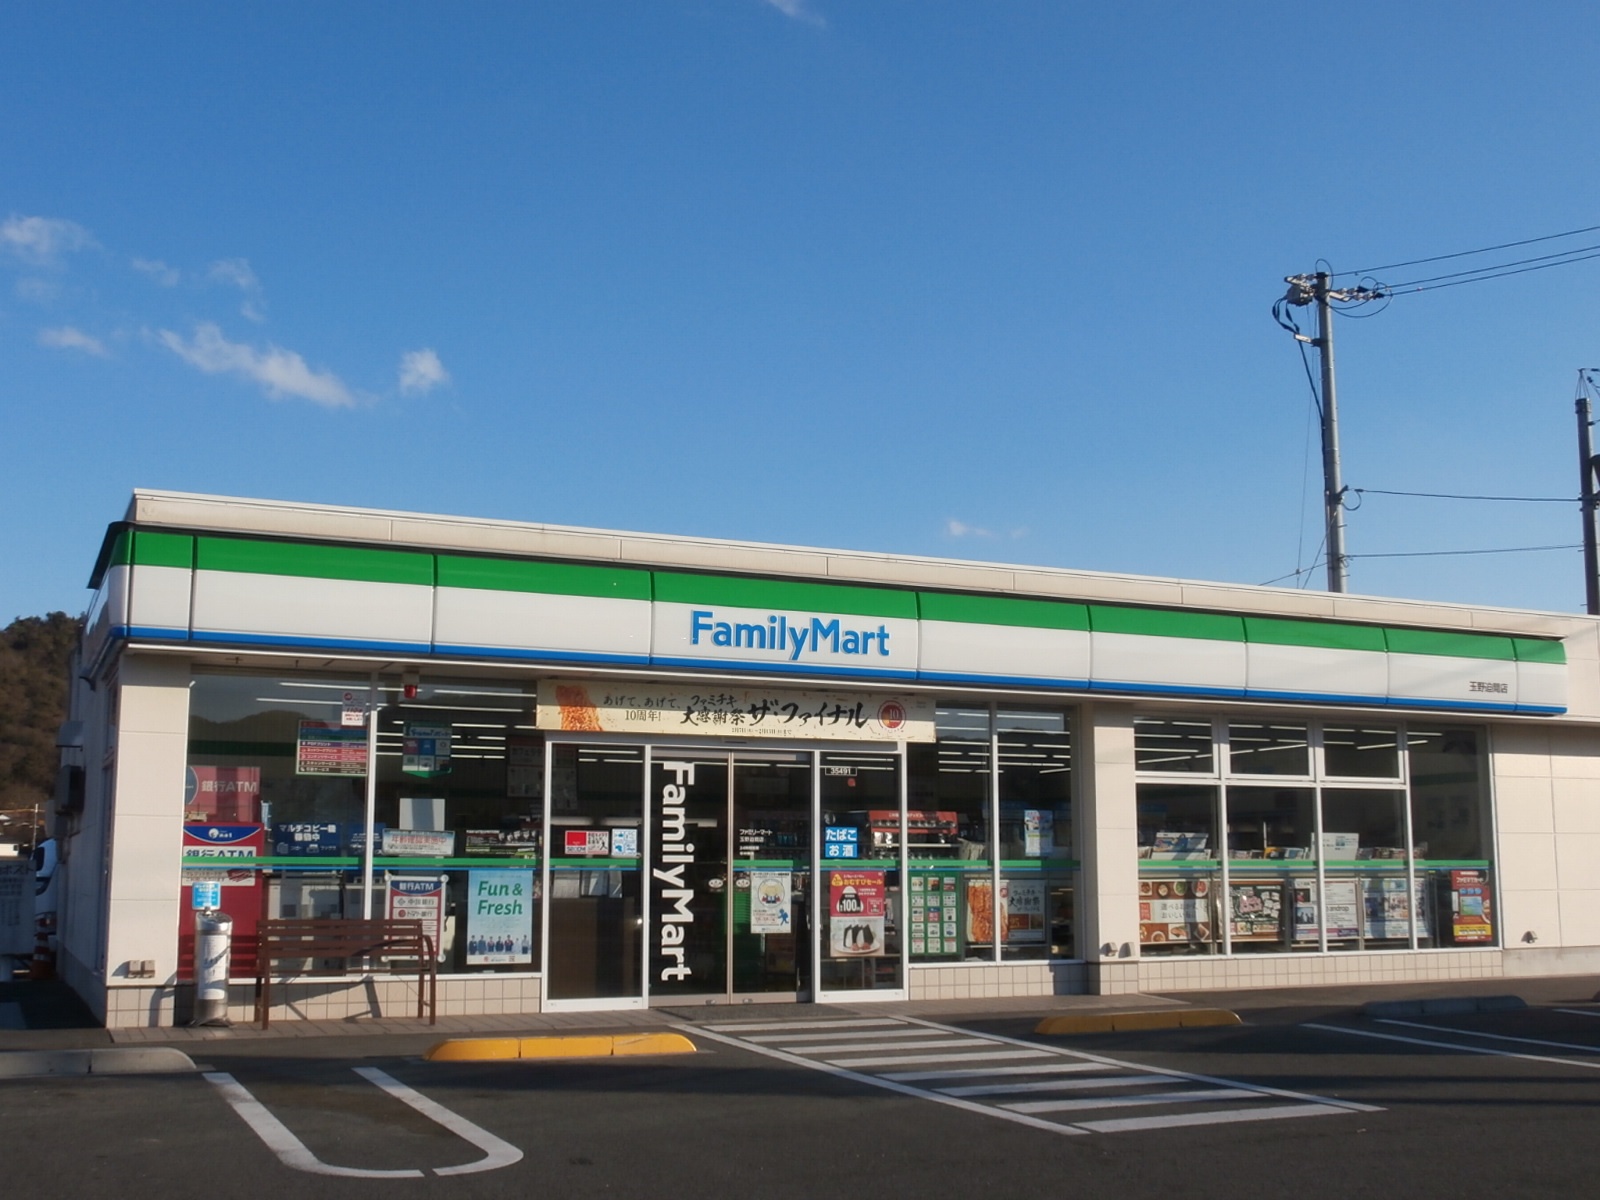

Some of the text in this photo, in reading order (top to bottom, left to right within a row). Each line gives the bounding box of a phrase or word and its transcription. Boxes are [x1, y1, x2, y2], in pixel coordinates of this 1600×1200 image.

[691, 610, 890, 661] FamilyMart
[690, 693, 738, 707] ファミチキ
[625, 709, 662, 722] 10周年!
[680, 705, 745, 726] 大感謝祭
[830, 767, 851, 775] 35491
[202, 780, 257, 793] 銀行ATM
[826, 829, 857, 842] たばこ
[829, 844, 854, 857] お酒
[653, 762, 695, 981] FamilyMart
[399, 882, 434, 891] 銀行ATM
[478, 880, 523, 896] Fun &
[477, 900, 523, 916] Fresh
[1329, 905, 1350, 913] androp
